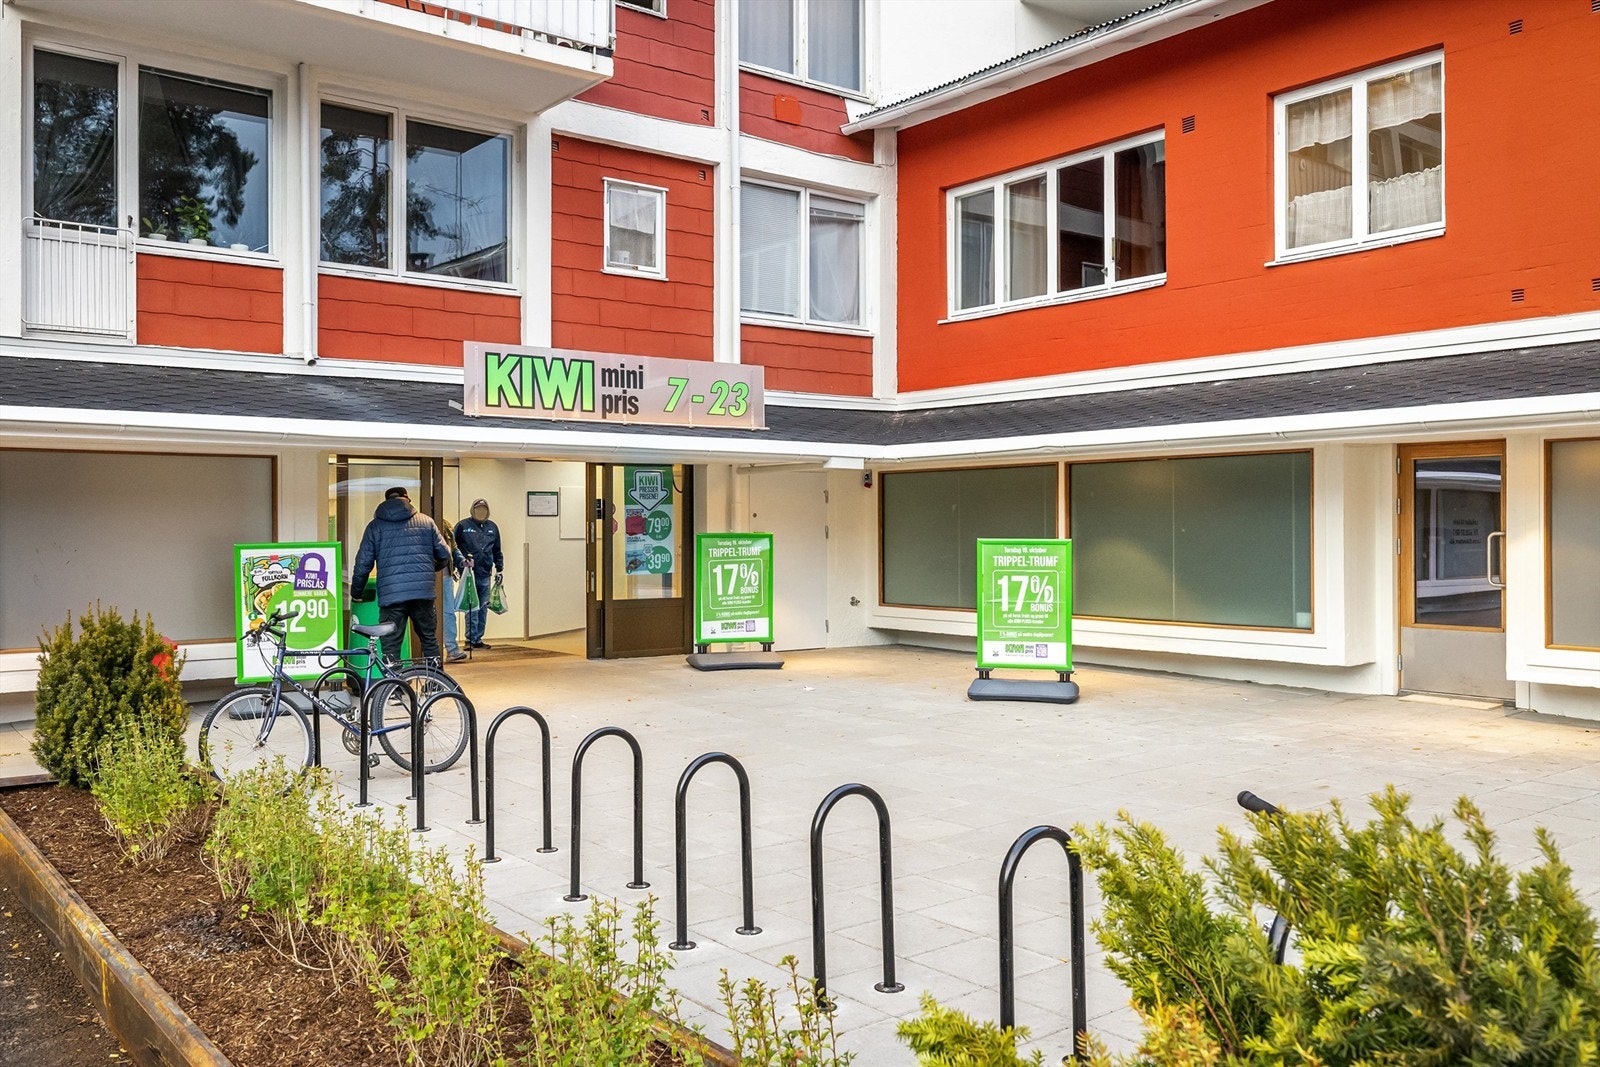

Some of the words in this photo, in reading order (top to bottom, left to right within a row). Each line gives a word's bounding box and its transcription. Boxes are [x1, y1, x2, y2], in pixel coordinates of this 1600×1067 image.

[485, 352, 595, 412] KIWI
[601, 363, 644, 390] mini
[601, 389, 640, 419] pris
[639, 476, 658, 486] KIWI
[708, 546, 762, 558] TRIPPEL-TRUMF
[993, 555, 1059, 567] TRIPPEL-TRUMF
[262, 574, 288, 582] FULLKORN
[296, 578, 325, 589] PRISLÅS
[712, 562, 759, 596] 17%
[740, 586, 759, 594] BONUS
[997, 575, 1054, 612] 17%
[1030, 603, 1054, 613] BONUS
[1005, 643, 1025, 653] KIWI
[303, 688, 343, 719] EVEREST
